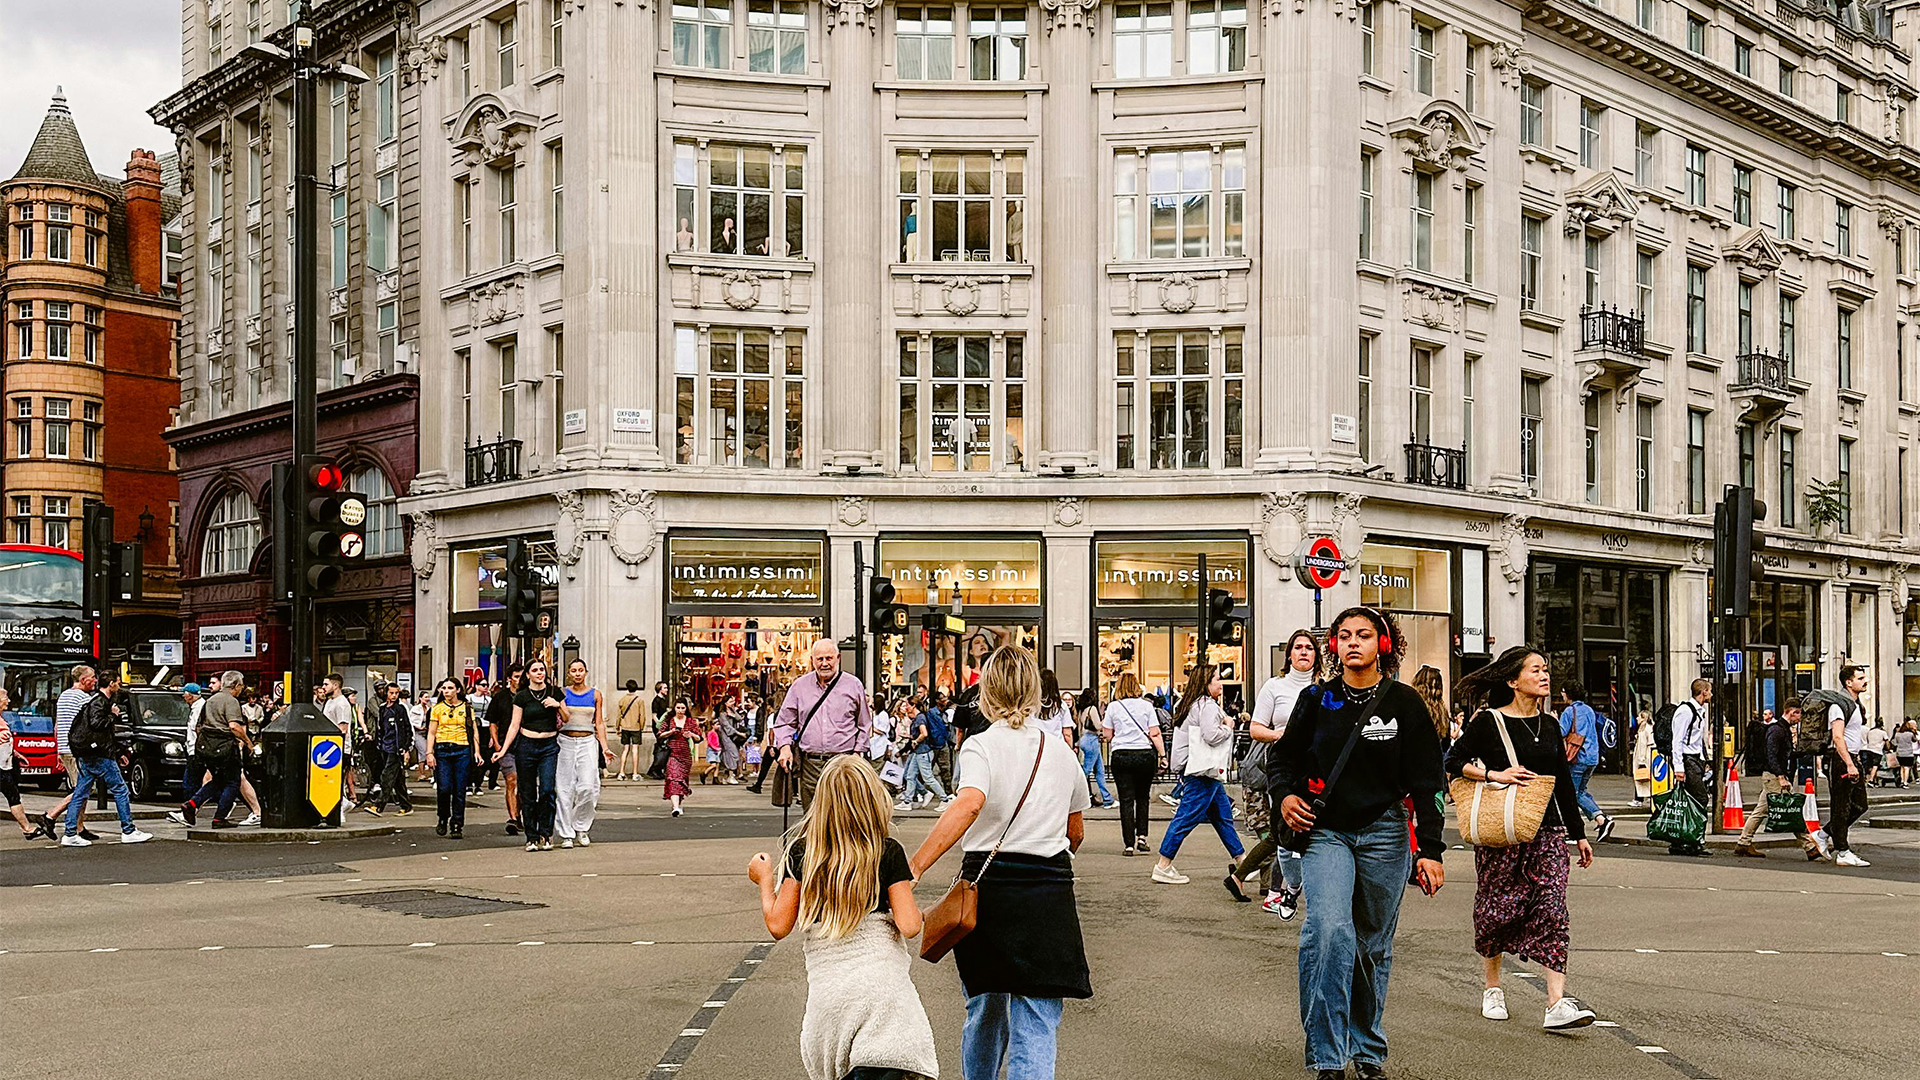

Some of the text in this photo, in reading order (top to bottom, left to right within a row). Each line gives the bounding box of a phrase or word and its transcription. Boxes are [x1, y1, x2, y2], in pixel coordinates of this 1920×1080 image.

[1465, 521, 1490, 533] 266-270
[1602, 533, 1628, 548] KIKO
[1306, 558, 1345, 569] UNDERGROUND
[675, 563, 812, 580] intimissimi
[892, 566, 1026, 581] intimissimi
[62, 626, 83, 643] 98
[18, 739, 56, 748] Metroline
